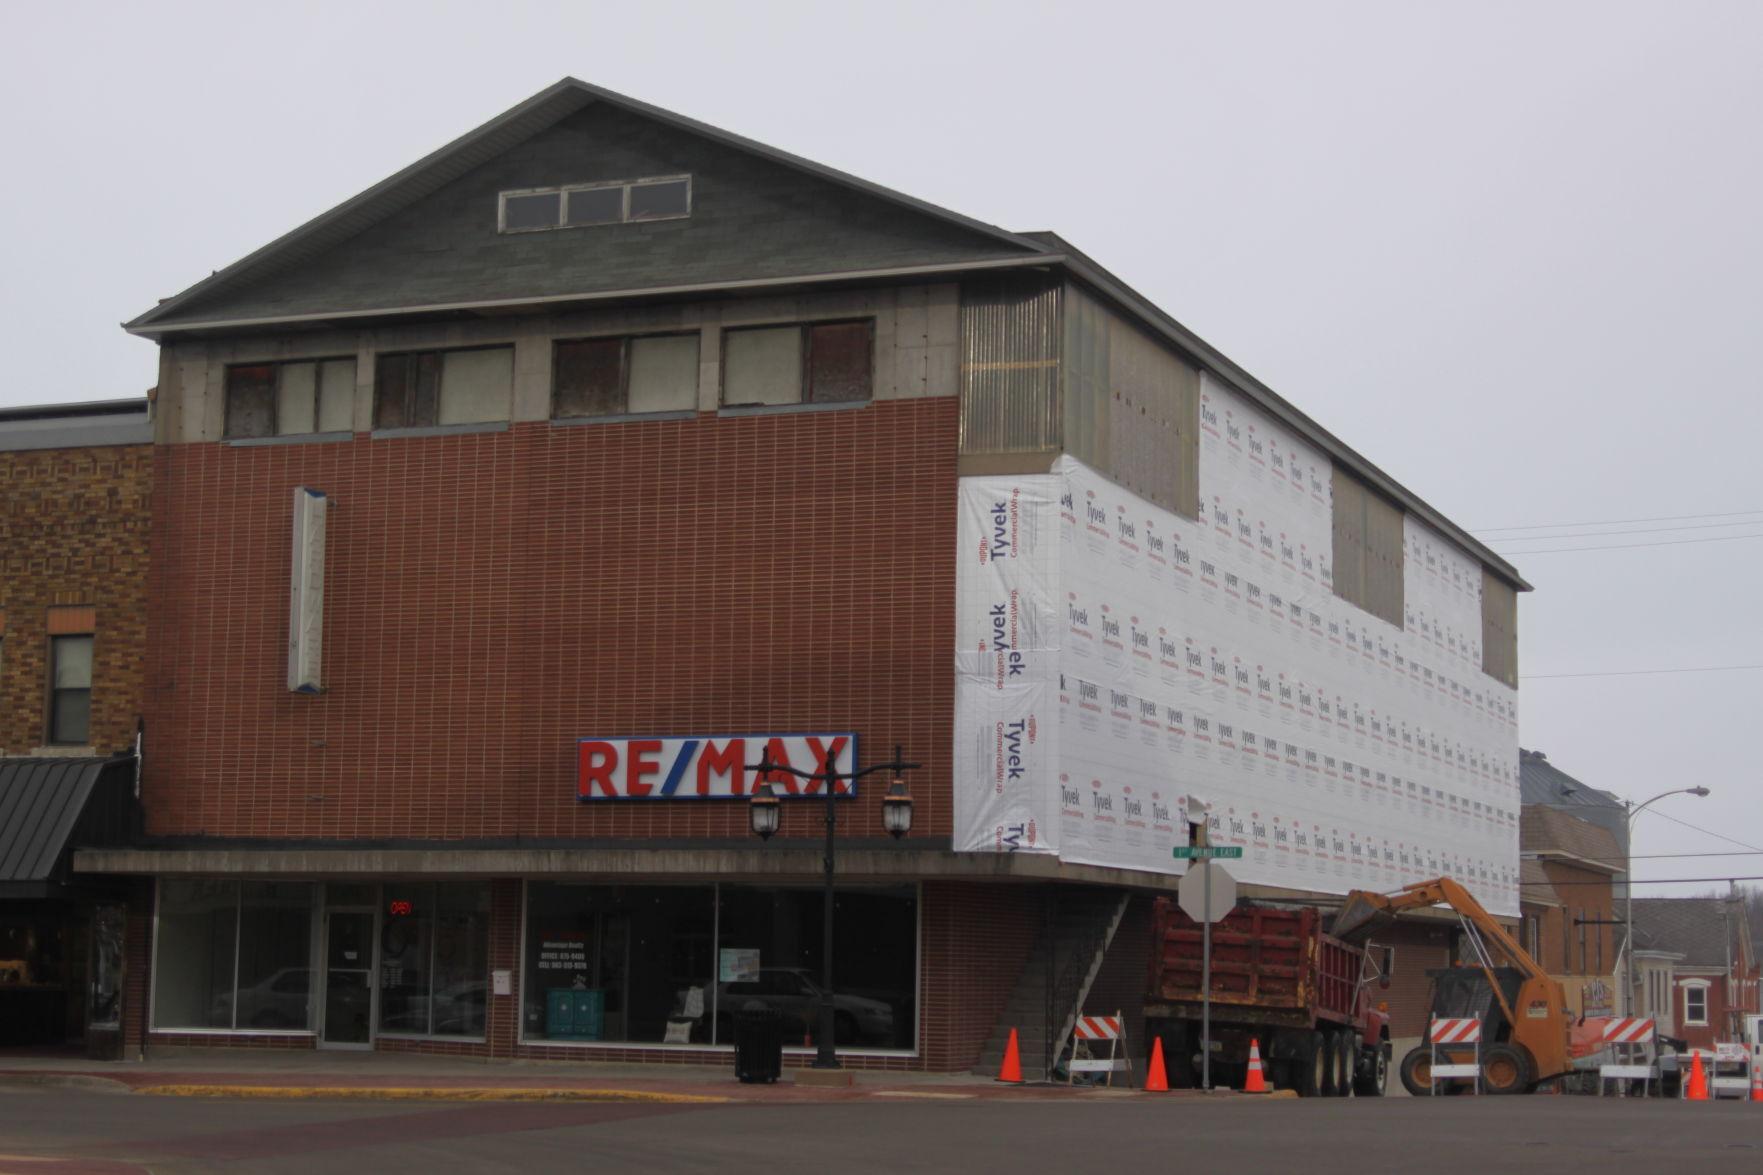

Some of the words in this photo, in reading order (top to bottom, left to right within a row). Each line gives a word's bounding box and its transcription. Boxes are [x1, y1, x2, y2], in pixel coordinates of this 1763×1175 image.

[1087, 501, 1106, 524] Tyvek
[991, 501, 1010, 561] Tyvek
[1118, 516, 1135, 538] Tyvek
[1009, 590, 1018, 650] mmercialWrap
[1069, 603, 1088, 625] Tyvek
[990, 604, 1010, 651] yvek
[1101, 615, 1119, 637] Tyvek
[1131, 626, 1148, 648] Tyvek
[1160, 637, 1176, 657] Tyvek
[1079, 680, 1098, 700] Tyvek
[1004, 719, 1024, 779] Tyvek
[579, 737, 849, 796] RE/MAX
[1061, 785, 1080, 807] Tyvek
[1093, 792, 1112, 812] Tyvek
[1124, 797, 1142, 818] Tyvek
[1003, 823, 1024, 852] Tyv
